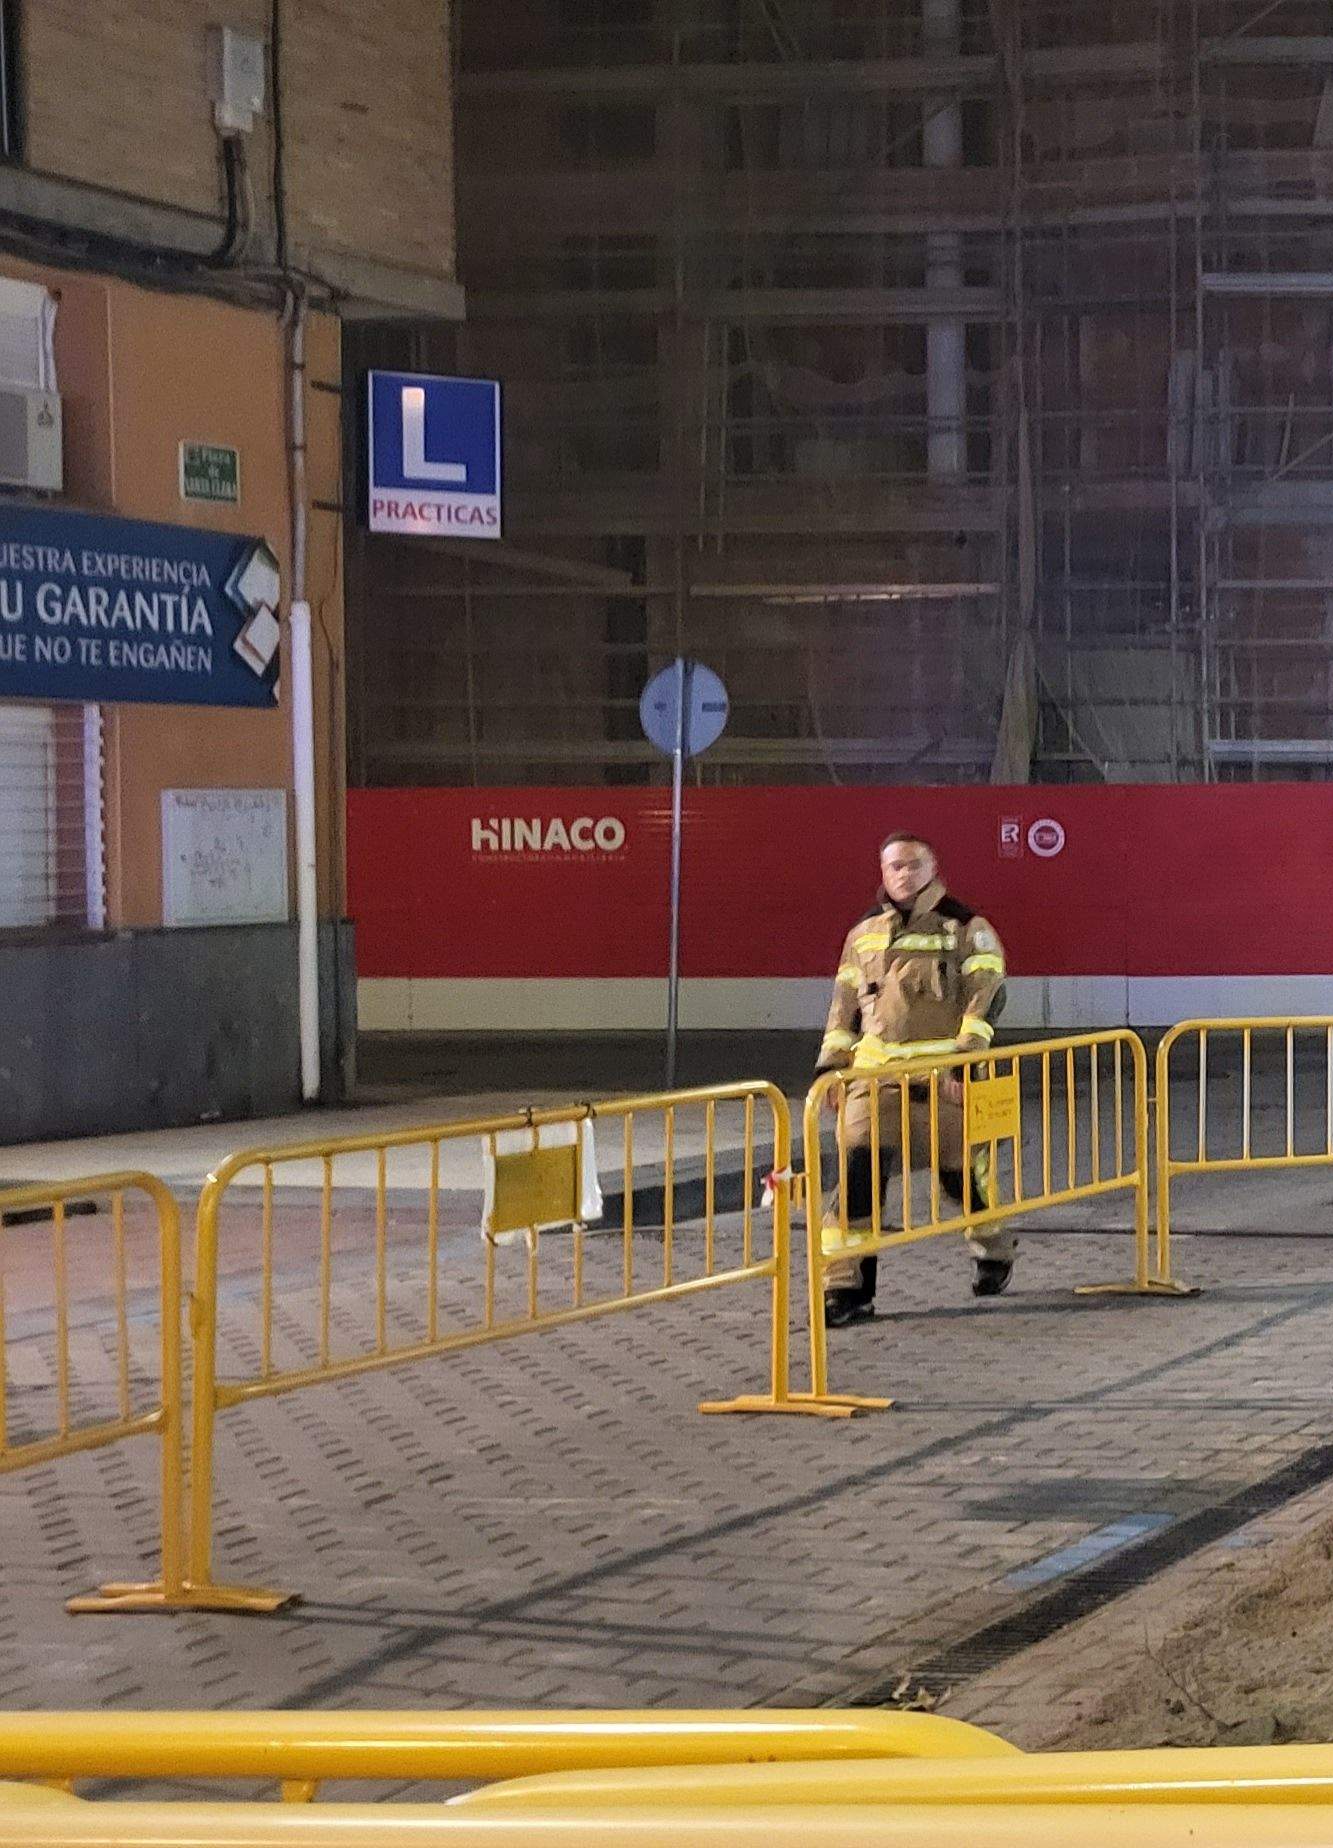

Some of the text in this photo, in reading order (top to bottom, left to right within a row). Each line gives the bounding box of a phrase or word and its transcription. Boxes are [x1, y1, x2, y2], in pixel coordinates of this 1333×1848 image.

[402, 387, 467, 482] L
[372, 499, 498, 525] PRACTICAS
[82, 550, 211, 588] EXPERIENCIA
[36, 582, 213, 637] GARANTÍA
[34, 635, 71, 664] NO
[77, 637, 103, 666] TE
[109, 638, 213, 675] ENGAÑEN
[471, 816, 626, 851] HINACO
